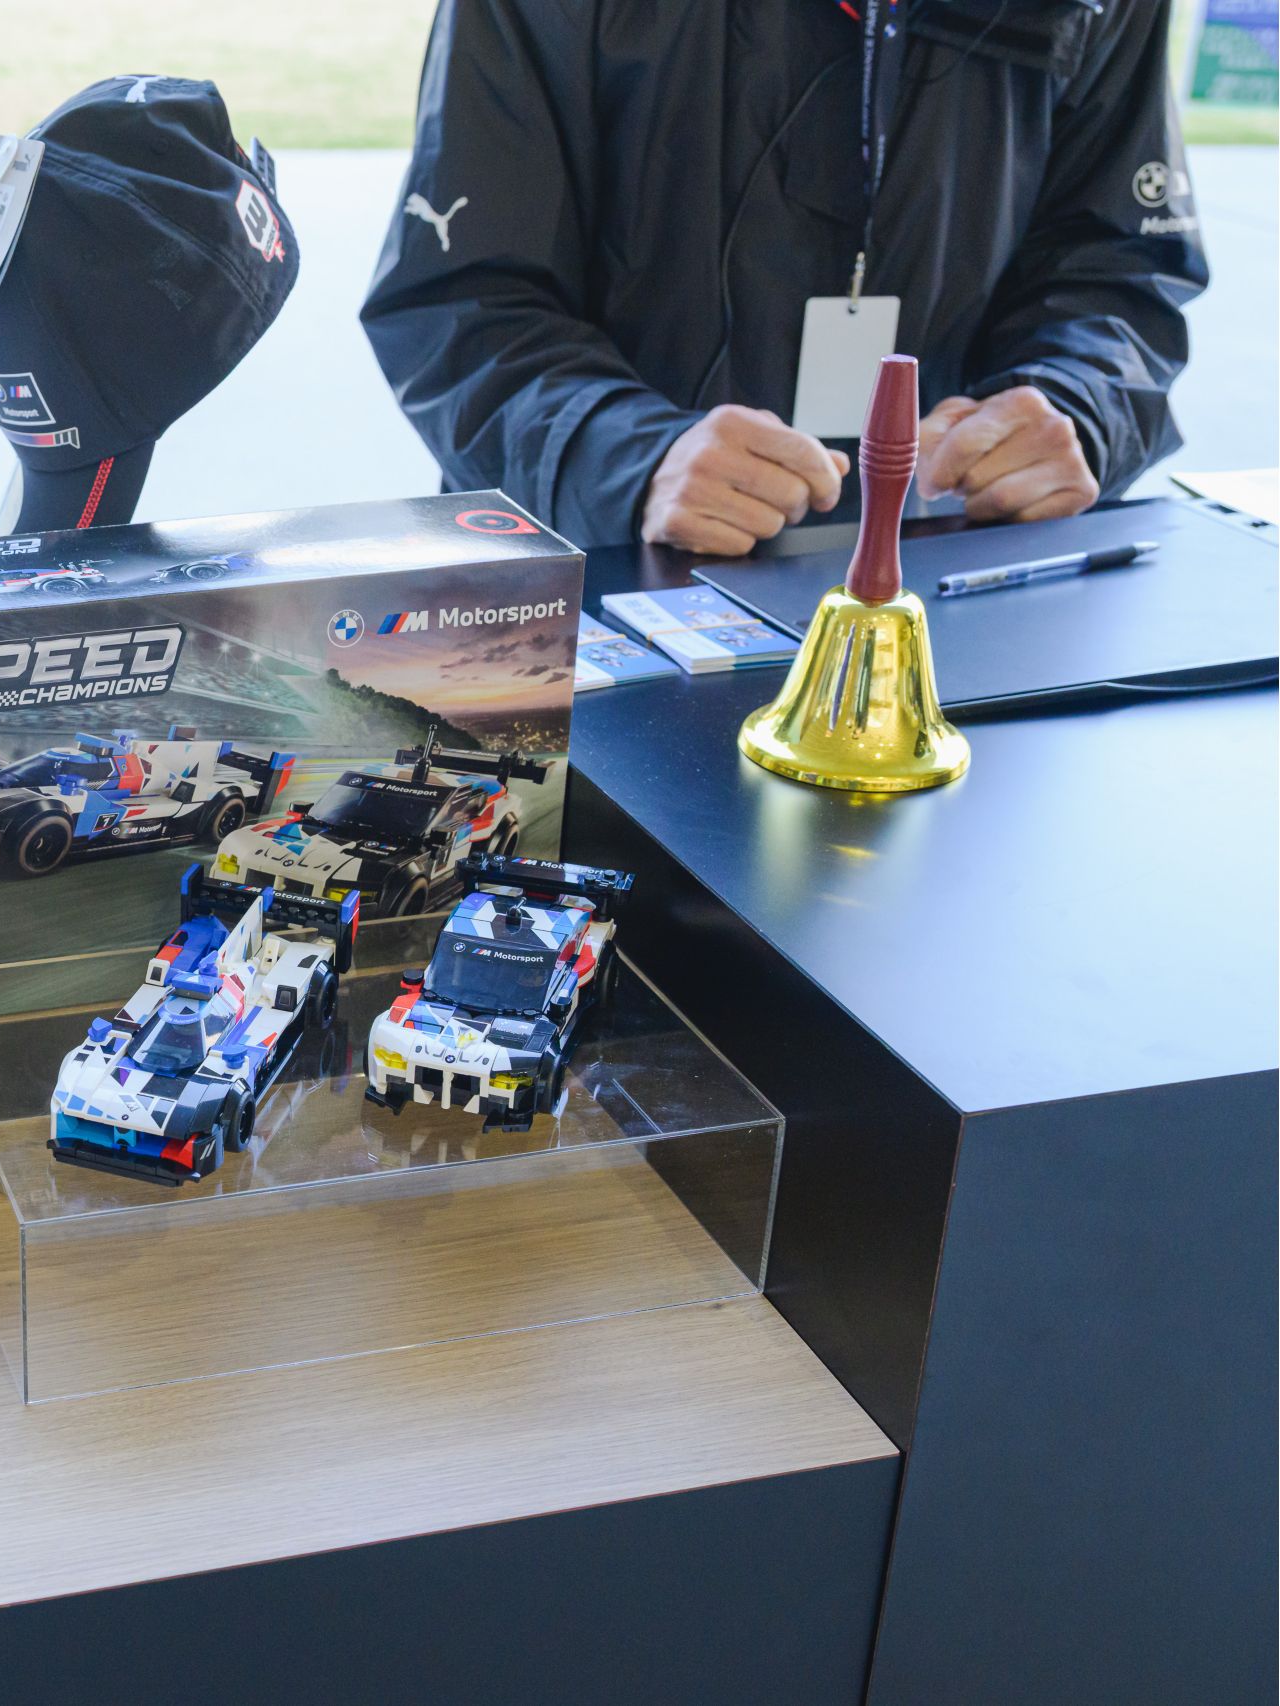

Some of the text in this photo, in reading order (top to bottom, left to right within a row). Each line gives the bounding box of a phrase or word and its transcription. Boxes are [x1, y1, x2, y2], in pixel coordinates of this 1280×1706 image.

[438, 597, 567, 629] Motorsport
[386, 784, 438, 797] Motorsport
[540, 860, 604, 875] Motorsport
[272, 890, 327, 905] otorsport
[493, 951, 544, 963] Motorsport
